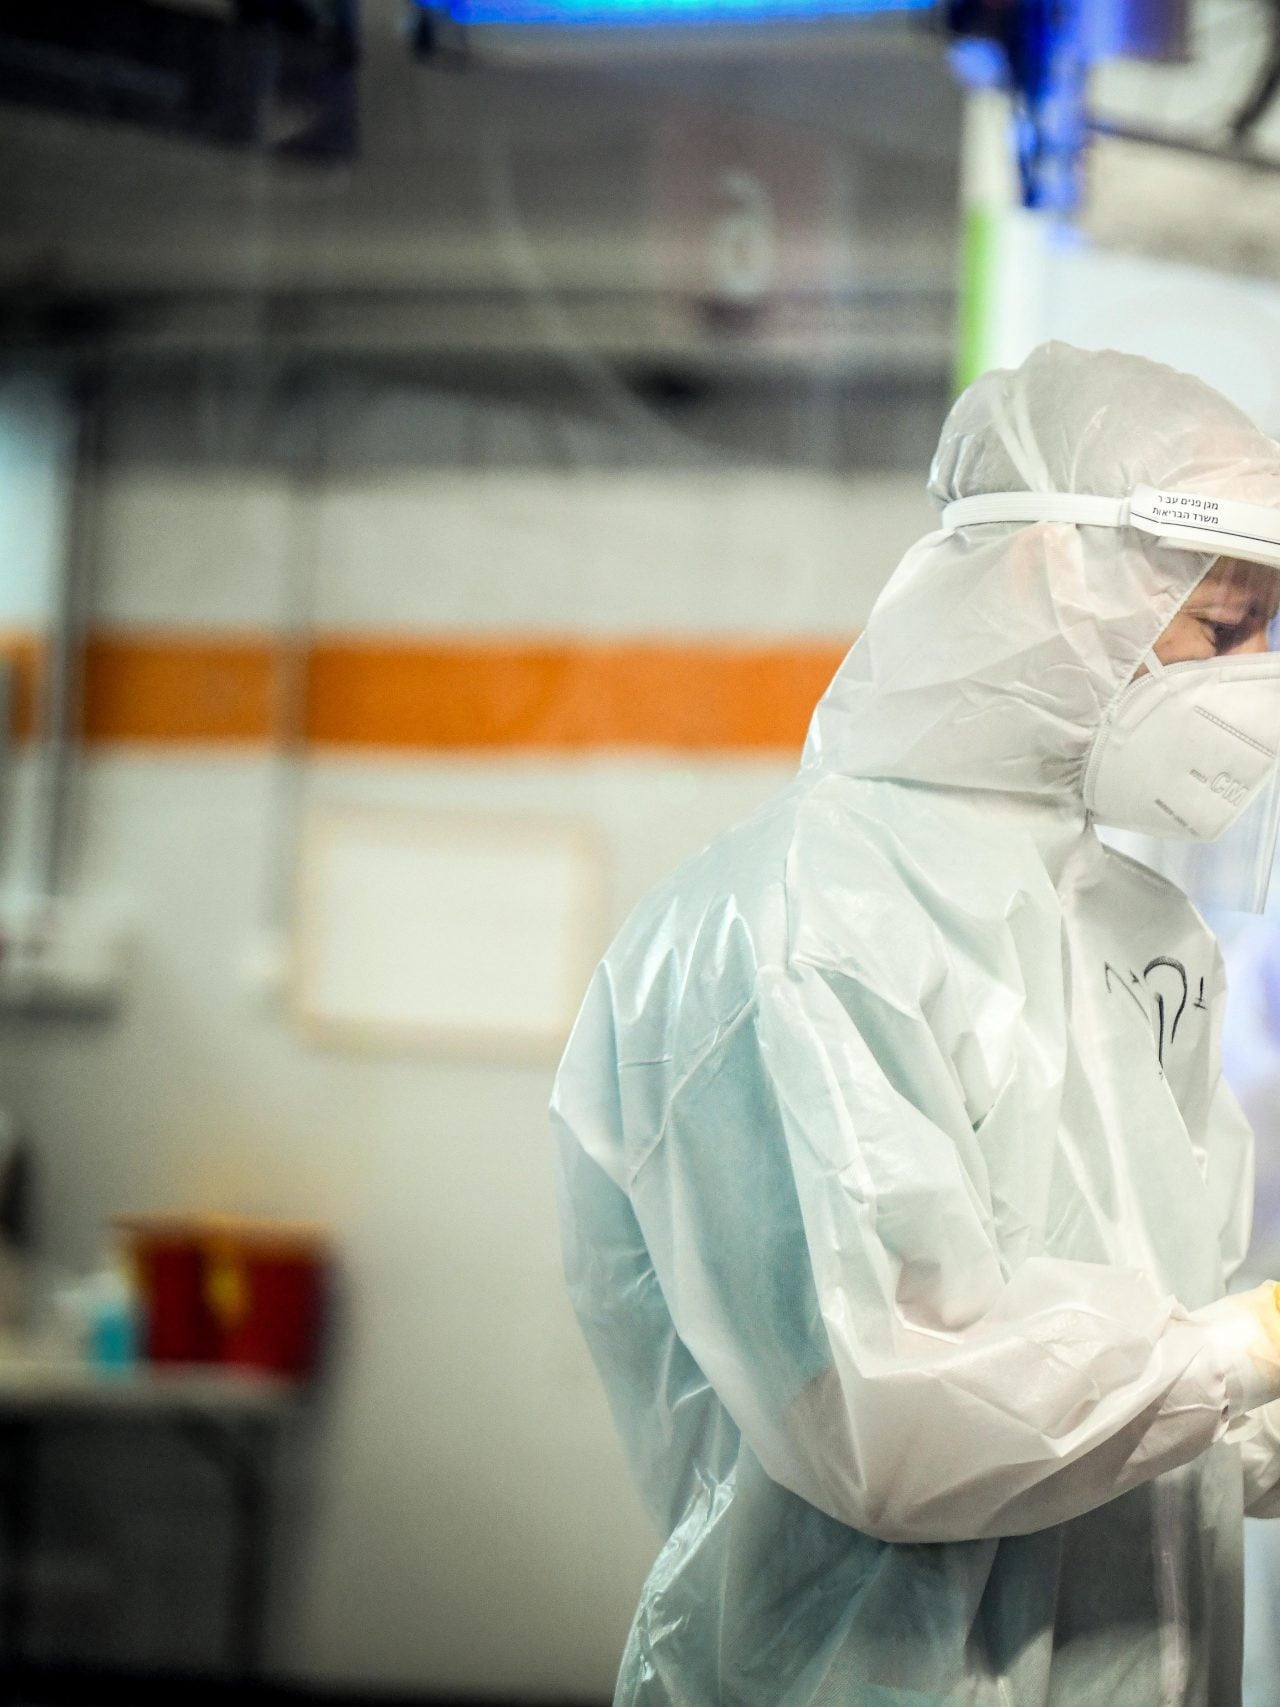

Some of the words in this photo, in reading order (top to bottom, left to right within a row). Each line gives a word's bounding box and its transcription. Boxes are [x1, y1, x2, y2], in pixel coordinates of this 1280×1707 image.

[1157, 494, 1179, 505] עבר
[1180, 497, 1202, 508] פנים
[1203, 500, 1219, 511] מגן
[1192, 512, 1219, 525] משרד
